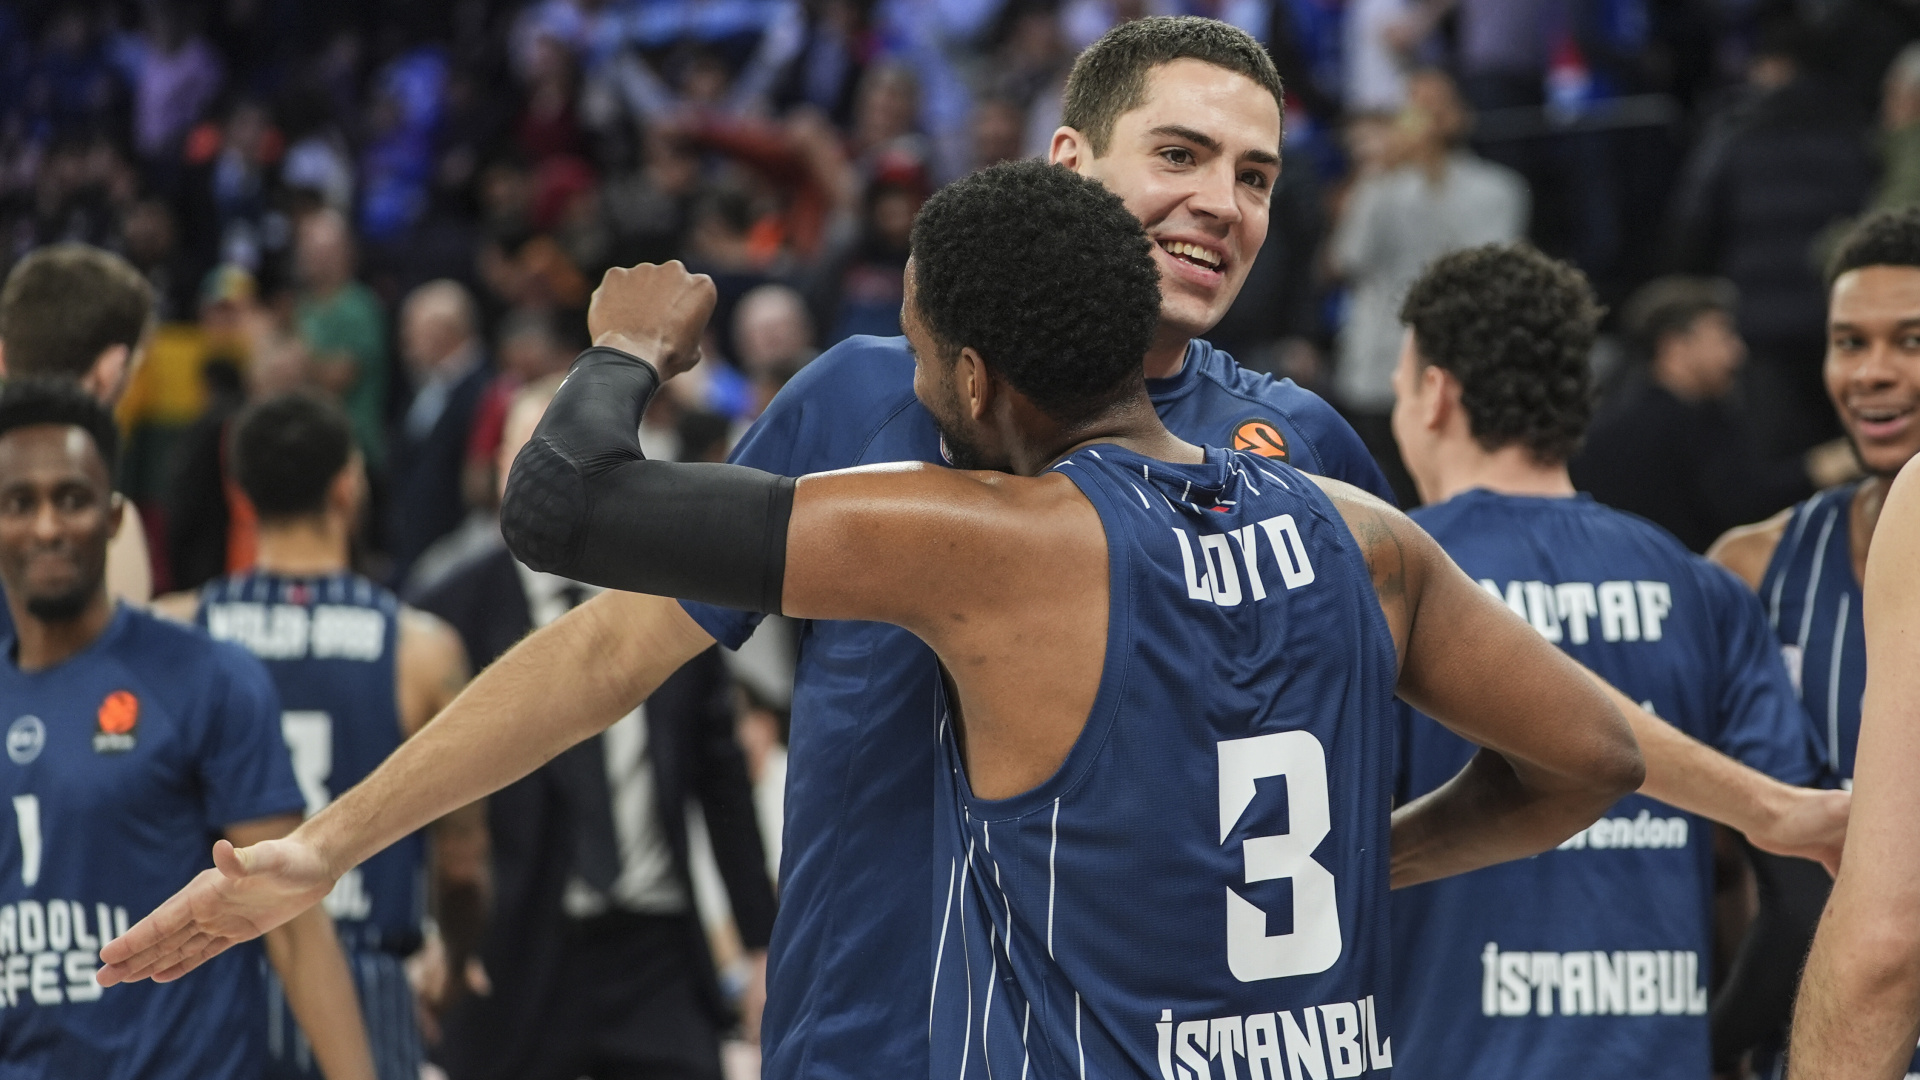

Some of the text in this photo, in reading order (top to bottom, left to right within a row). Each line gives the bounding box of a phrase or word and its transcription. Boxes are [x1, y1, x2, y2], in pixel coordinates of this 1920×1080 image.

[1171, 513, 1316, 607] LOYD
[1216, 729, 1342, 983] 3
[0, 951, 105, 1008] FES
[1481, 941, 1708, 1017] İSTANBUL
[1155, 994, 1394, 1080] İSTANBL
